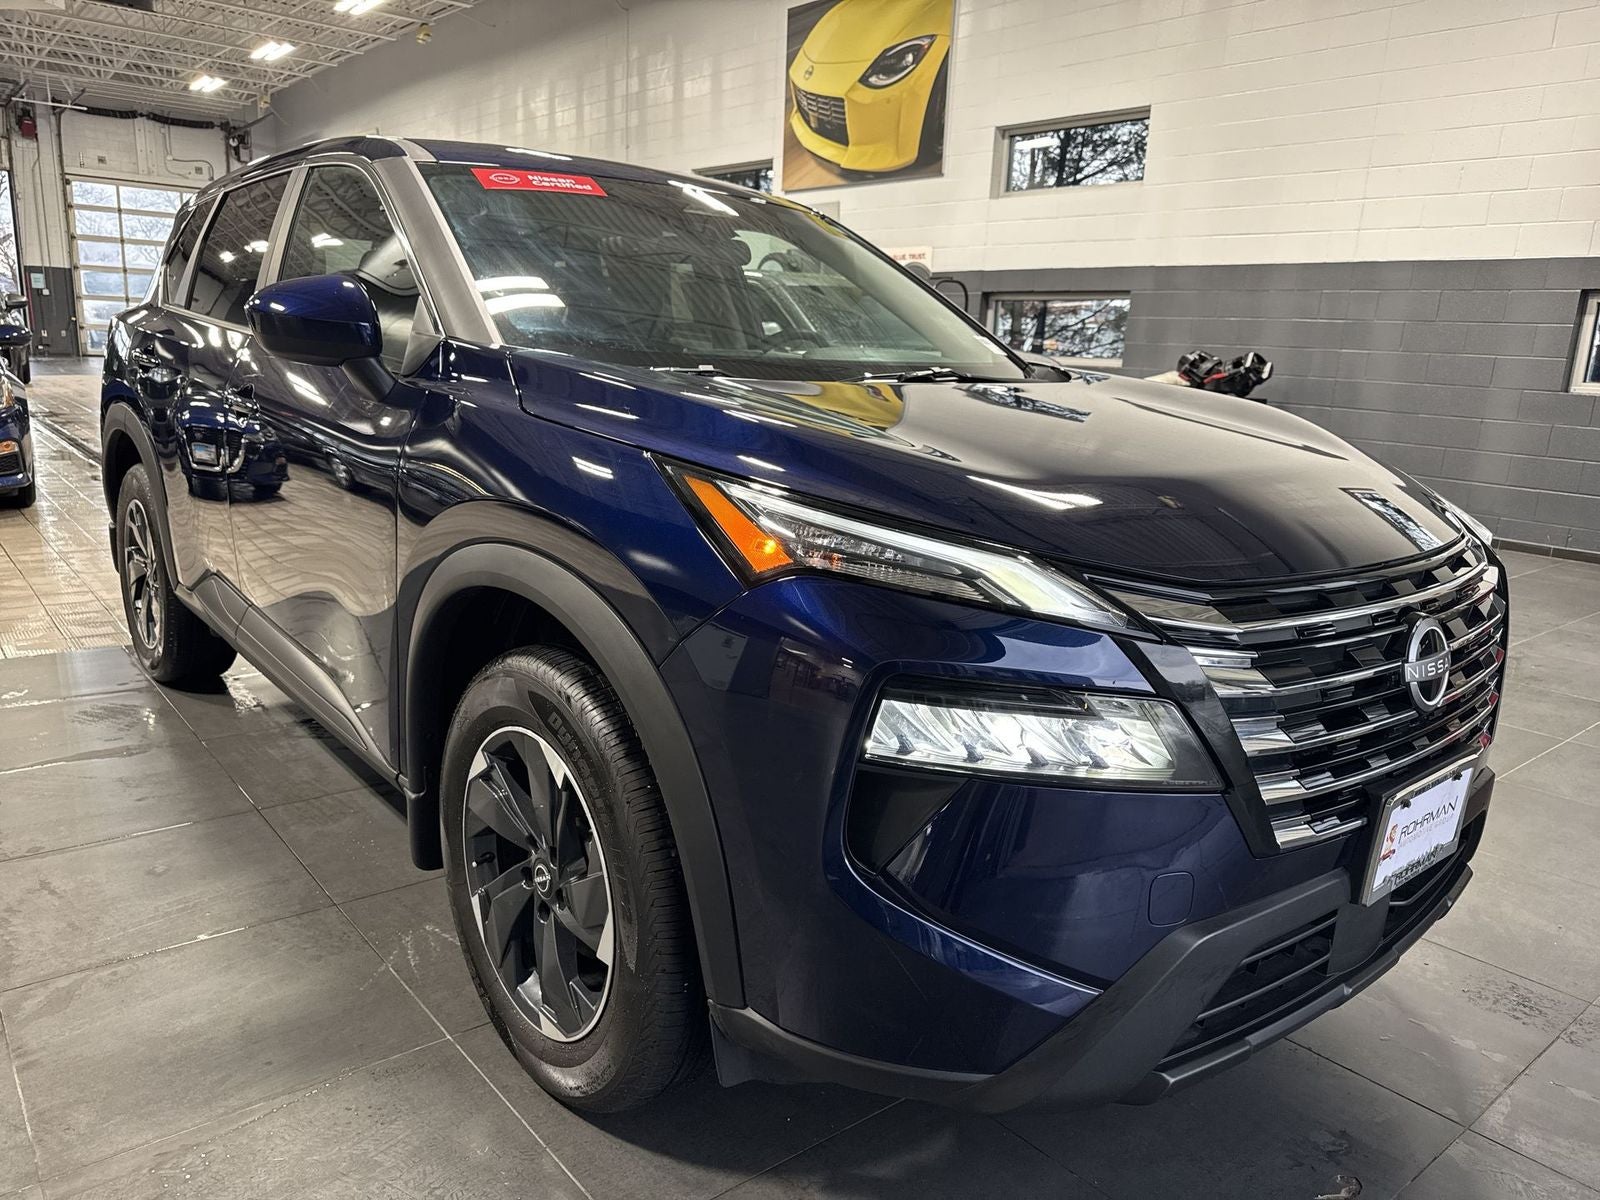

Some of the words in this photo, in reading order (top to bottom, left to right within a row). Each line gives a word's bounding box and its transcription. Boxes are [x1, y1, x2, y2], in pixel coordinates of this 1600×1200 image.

[527, 174, 576, 184] Nissan
[532, 180, 593, 190] Certified
[1398, 795, 1459, 844] ROHRMAN
